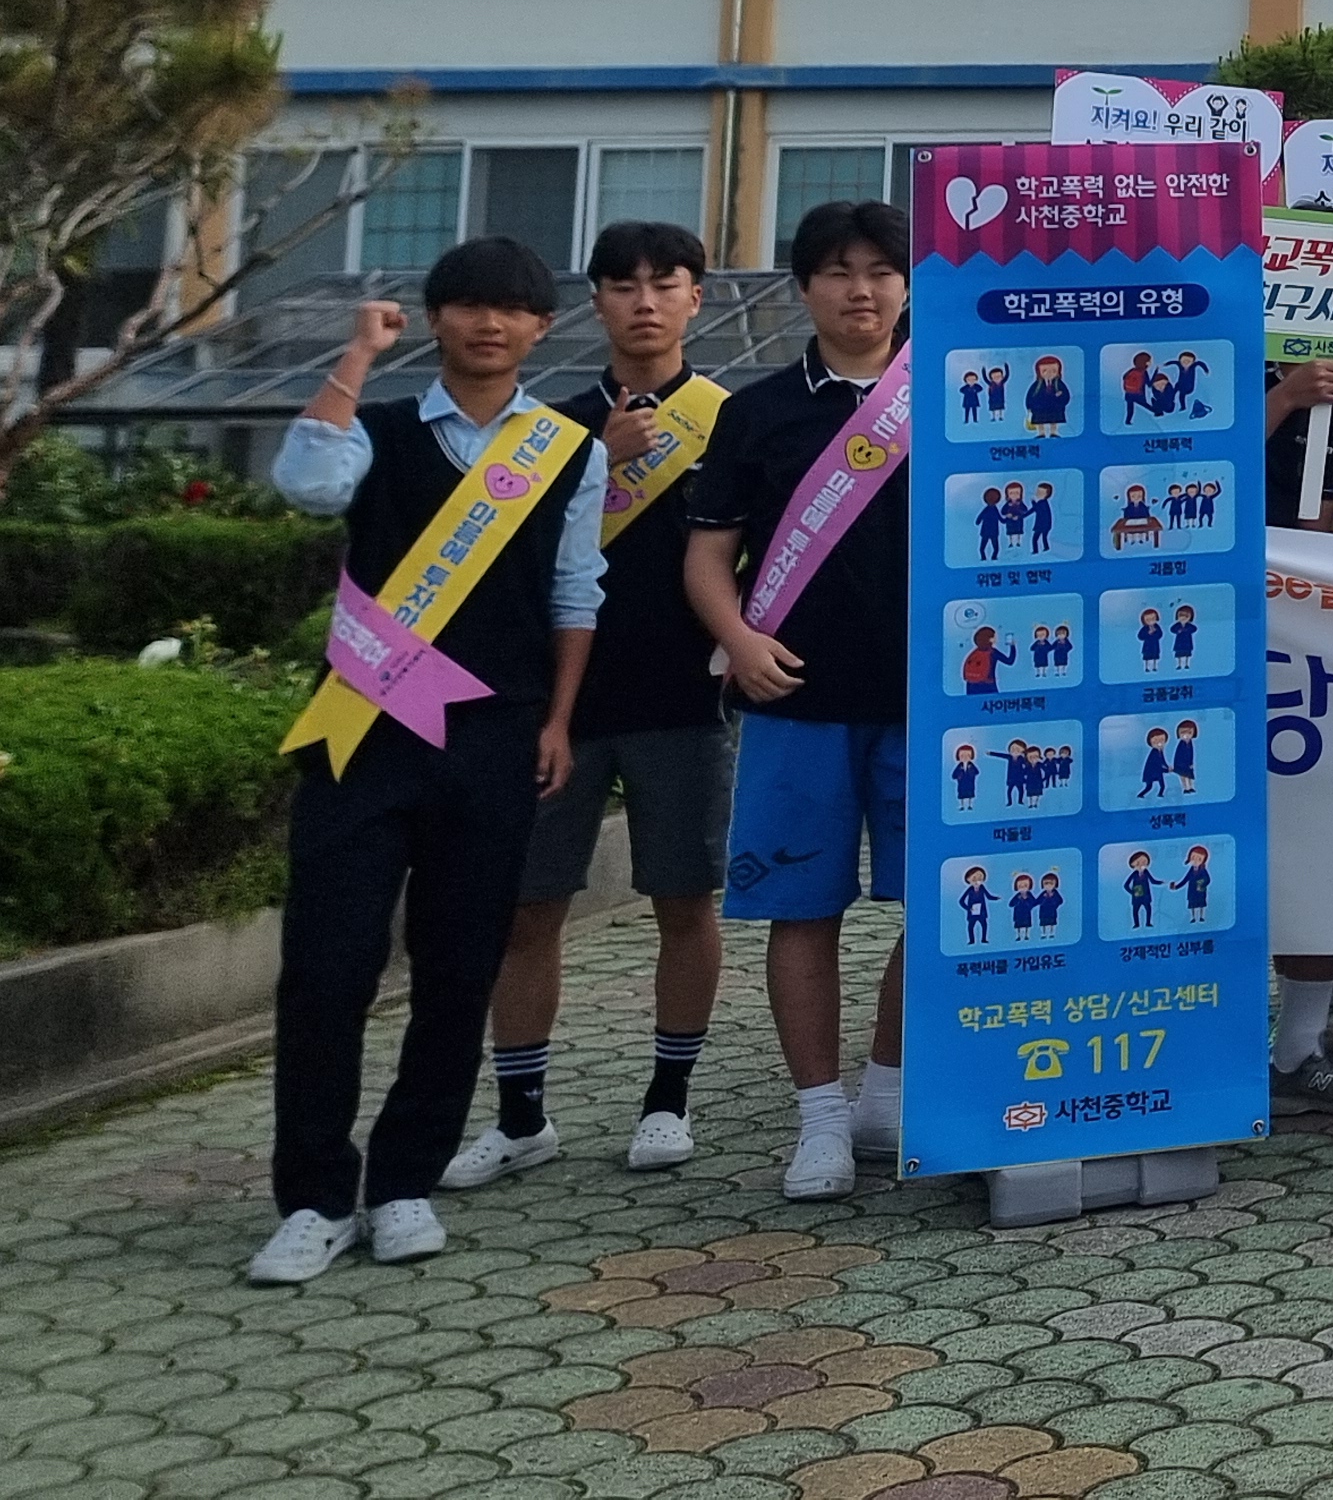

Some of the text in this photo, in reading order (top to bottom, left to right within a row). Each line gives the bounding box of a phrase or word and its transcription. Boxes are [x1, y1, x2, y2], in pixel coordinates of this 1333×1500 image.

[1090, 105, 1248, 141] 지켜요! 우리 같이
[1015, 171, 1230, 200] 학교폭력 없는 안전한
[1015, 202, 1128, 229] 사천중학교
[1003, 287, 1184, 320] 학교폭력의 유형
[1142, 436, 1194, 454] 신체폭력
[1008, 570, 1023, 587] 및
[1148, 560, 1187, 577] 괴롭힘
[980, 696, 1047, 714] 사이버폭력
[1148, 812, 1187, 830] 성폭력
[1013, 938, 1215, 973] 가입유도 강제적인 심부름
[958, 981, 1219, 1033] 학교폭력 상담/신고센터
[1086, 1028, 1168, 1075] 117
[1054, 1088, 1173, 1125] 사천중학교
